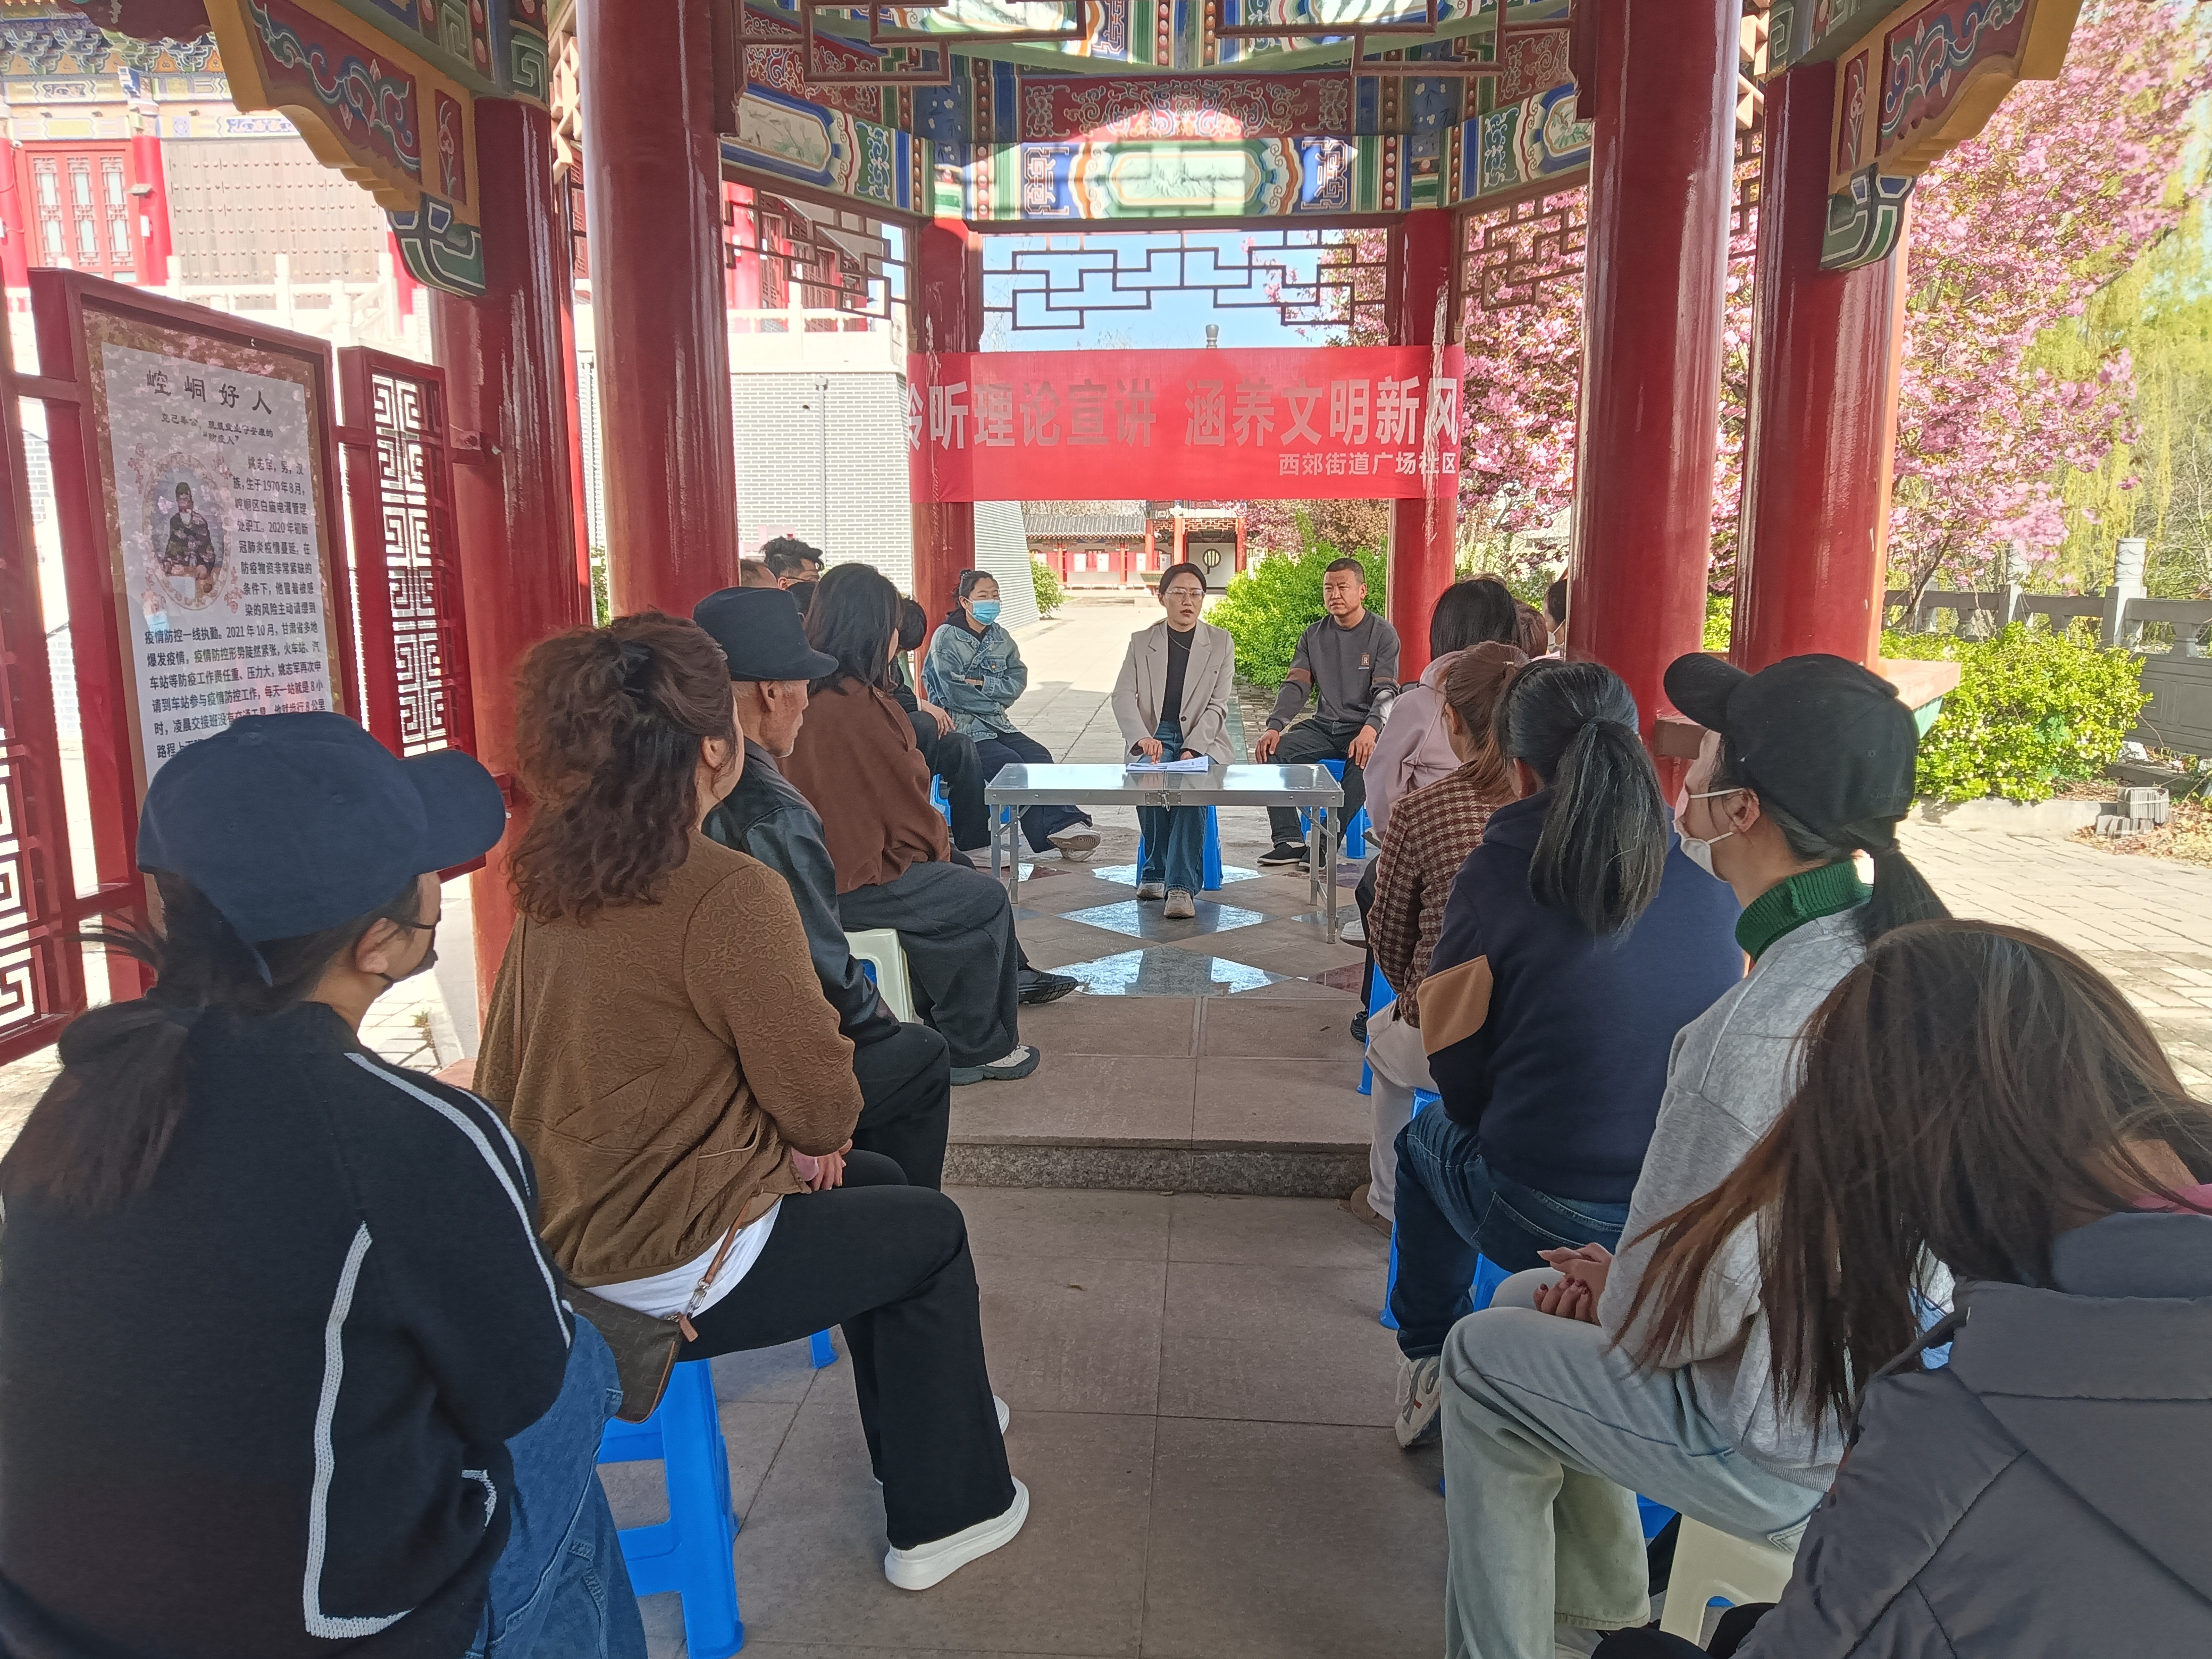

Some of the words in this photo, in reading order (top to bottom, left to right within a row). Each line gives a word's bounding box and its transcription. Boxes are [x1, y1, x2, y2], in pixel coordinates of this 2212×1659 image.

[146, 370, 272, 415] 崆峒好人
[1185, 375, 1459, 446] 涵养文明新风
[1279, 452, 1456, 476] 西郊街道广场社区
[241, 561, 313, 575] 防疫物资非常紧缺的
